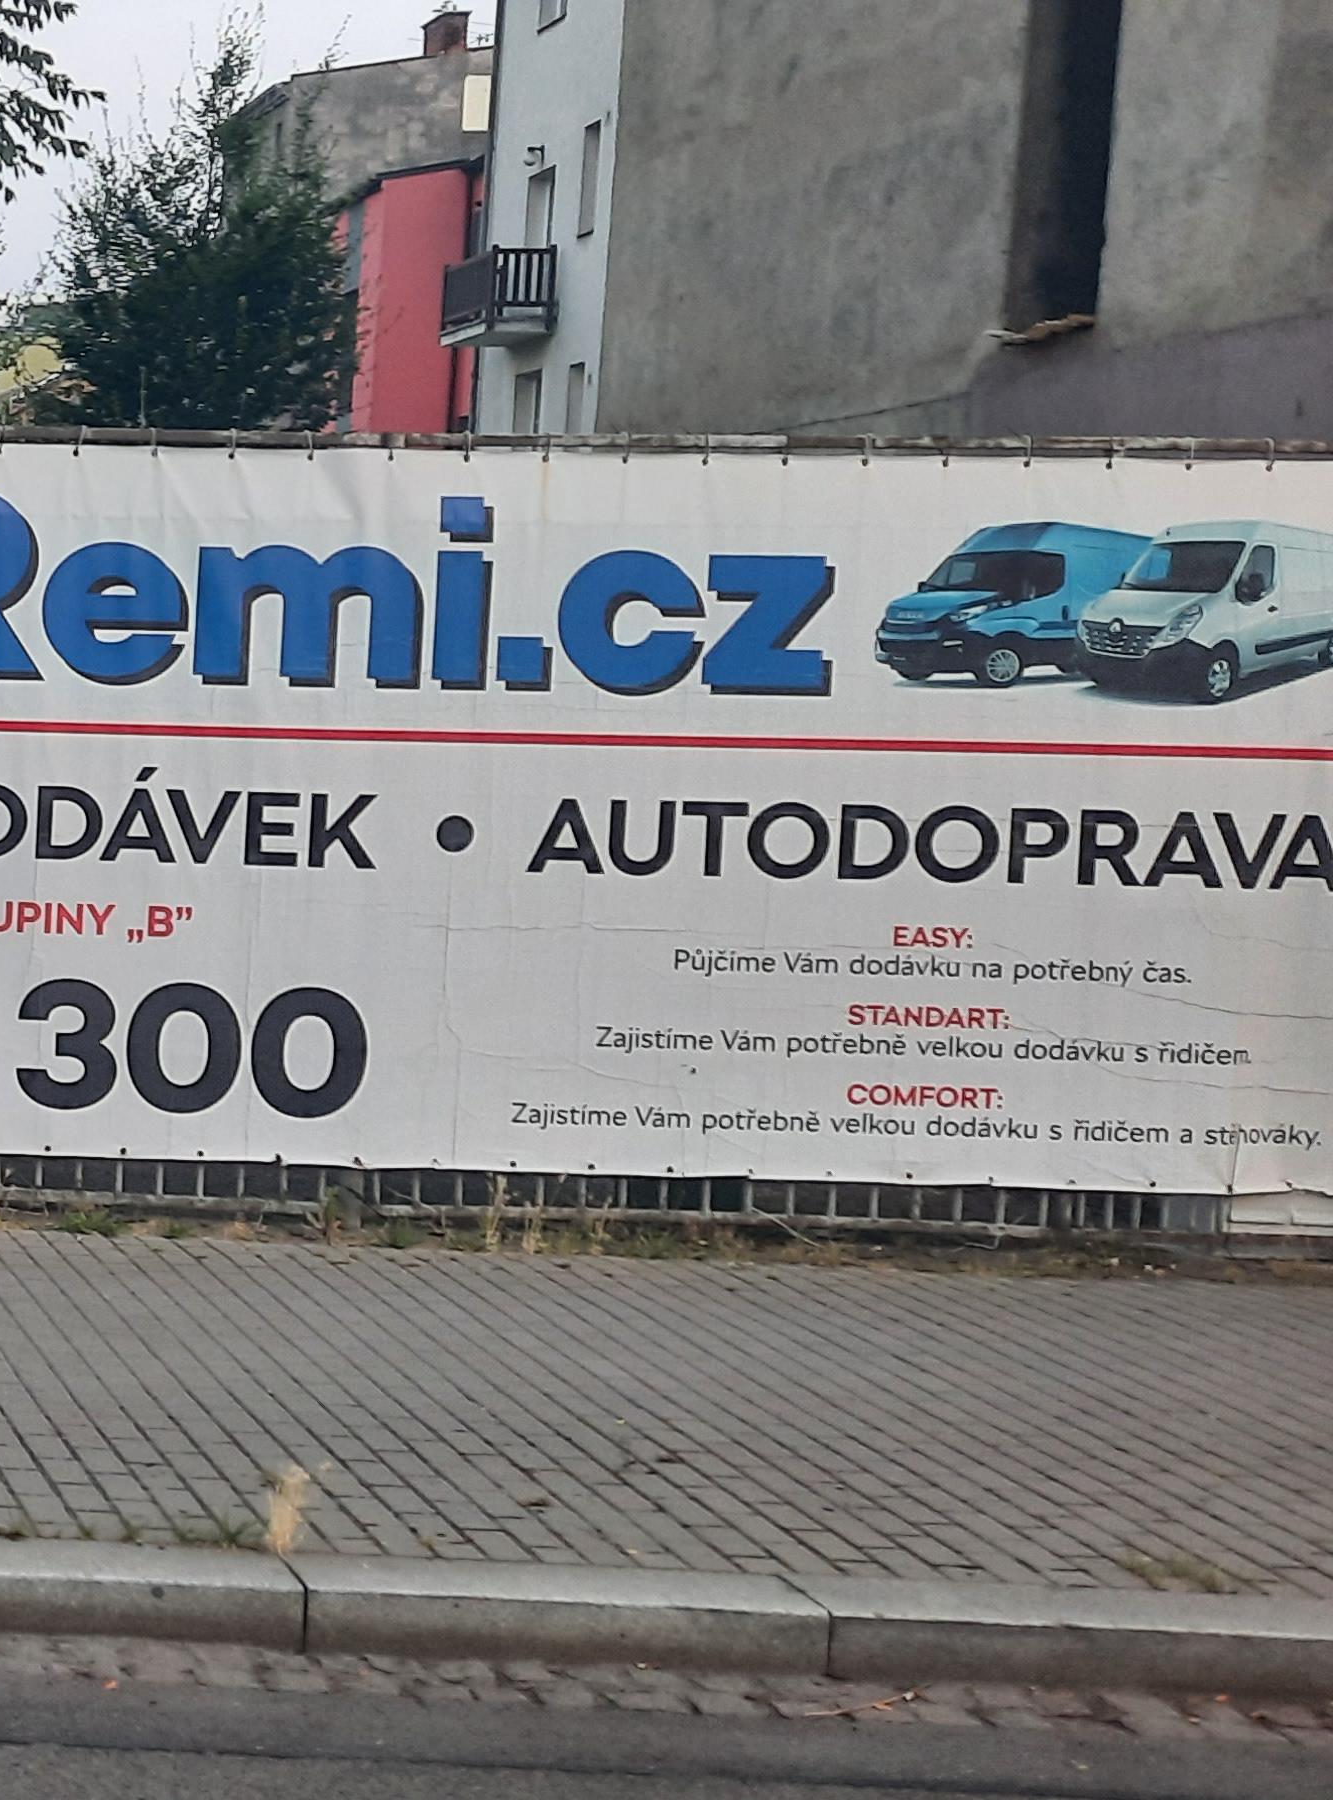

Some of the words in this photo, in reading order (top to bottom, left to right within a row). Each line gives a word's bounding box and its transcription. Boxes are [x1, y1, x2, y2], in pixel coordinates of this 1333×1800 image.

[527, 799, 1333, 892] AUTODOPRAVA
[892, 926, 974, 951] EASY:
[674, 948, 776, 977] Půjčíme
[783, 952, 839, 974] Vám
[849, 954, 961, 977] dodávku
[971, 962, 1003, 978] na
[1012, 958, 1133, 986] potřebný
[1142, 960, 1192, 984] čas.
[847, 1004, 1010, 1030] STANDART:
[15, 978, 367, 1120] 300
[595, 1026, 713, 1053] Zajistíme
[721, 1030, 776, 1053] Vám
[786, 1031, 907, 1058] potřebně
[916, 1036, 1002, 1059] velkou
[1013, 1039, 1124, 1062] dodávku
[1134, 1047, 1149, 1062] s
[846, 1083, 1004, 1110] COMFORT:
[511, 1102, 627, 1131] Zajistíme
[635, 1106, 691, 1129] Vám
[701, 1110, 820, 1135] potřebně
[830, 1113, 915, 1136] velkou
[925, 1115, 1038, 1139] dodávku
[1048, 1125, 1062, 1141] s
[1072, 1120, 1169, 1144] řidičem
[1179, 1130, 1193, 1144] a
